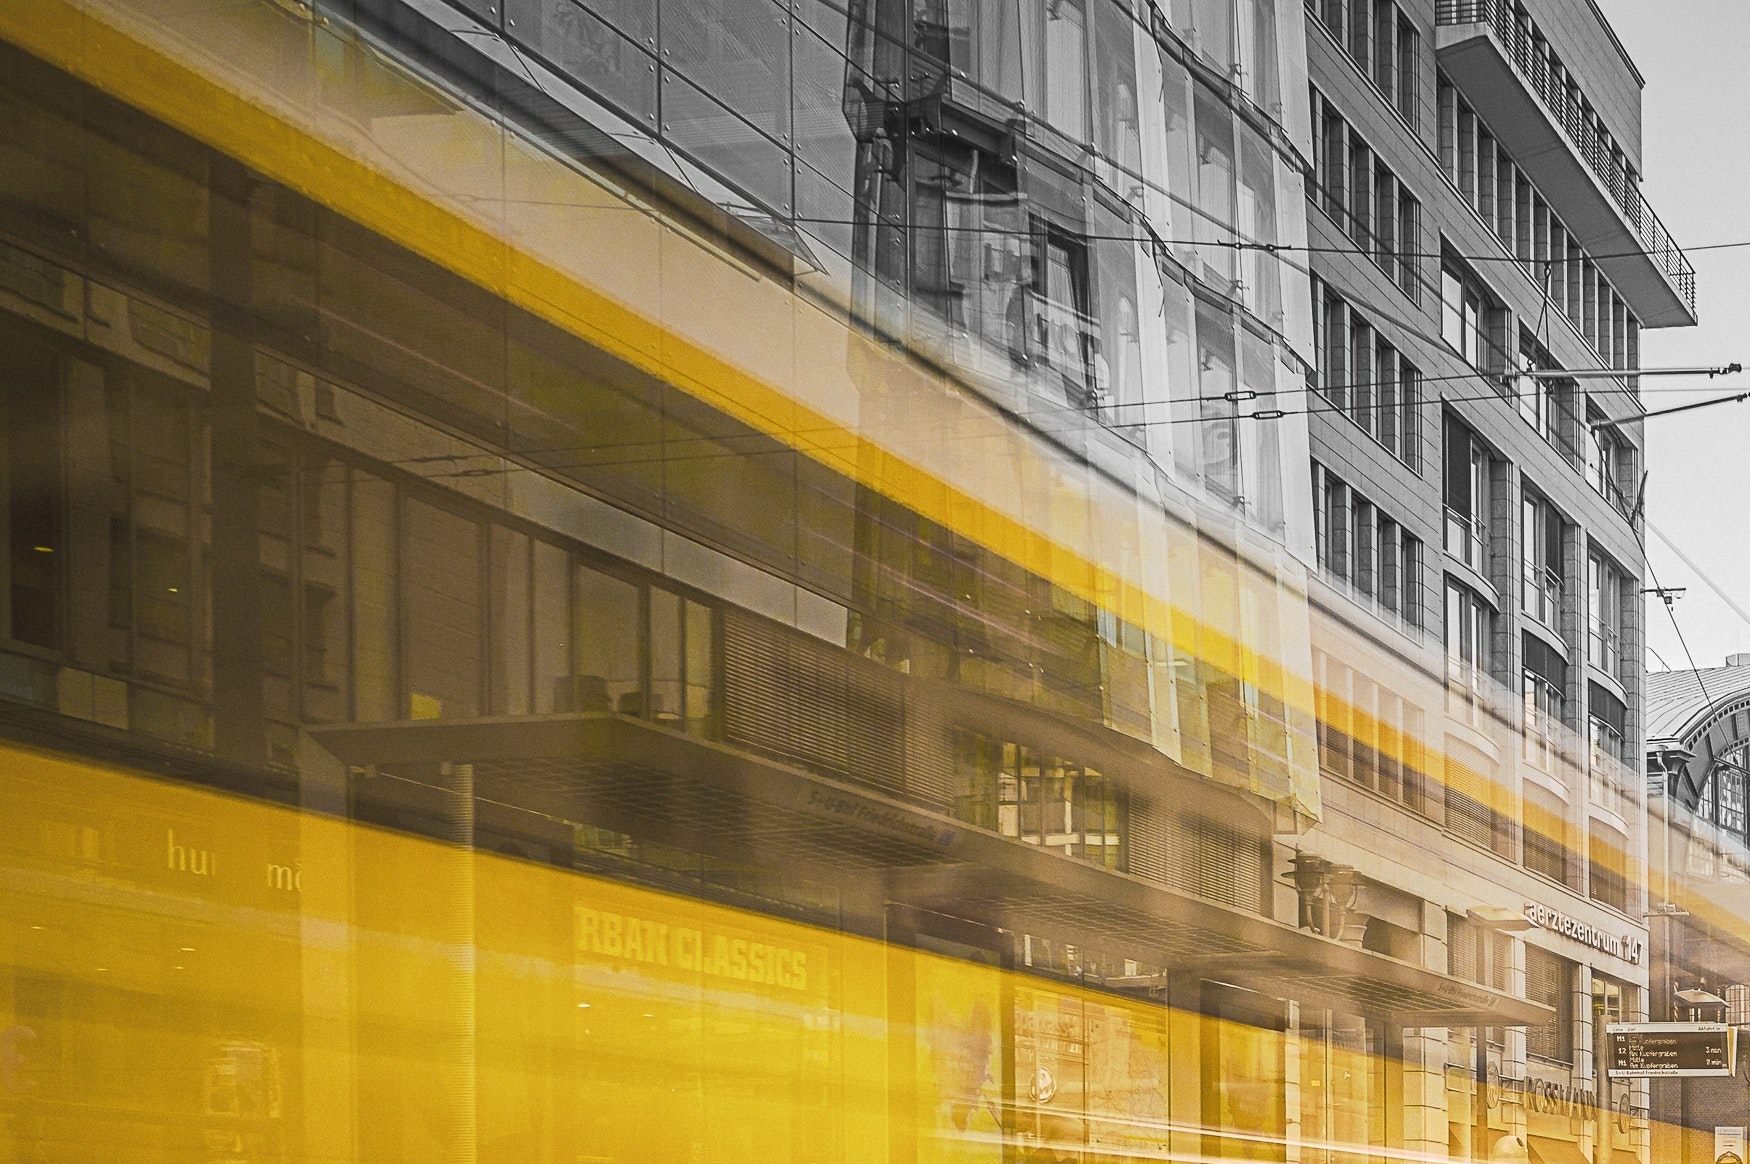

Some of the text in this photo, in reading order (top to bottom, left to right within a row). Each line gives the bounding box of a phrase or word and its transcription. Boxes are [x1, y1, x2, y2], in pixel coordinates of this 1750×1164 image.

[1529, 901, 1620, 957] aerztezentrum
[674, 925, 808, 991] CLASSICS
[1618, 1047, 1627, 1055] 12
[1705, 1046, 1710, 1054] 3
[1639, 1049, 1678, 1058] Kupfergraben
[1618, 1059, 1627, 1067] M1
[1640, 1061, 1679, 1070] Kupfergraben
[1524, 1076, 1598, 1122] ROSSMANN
